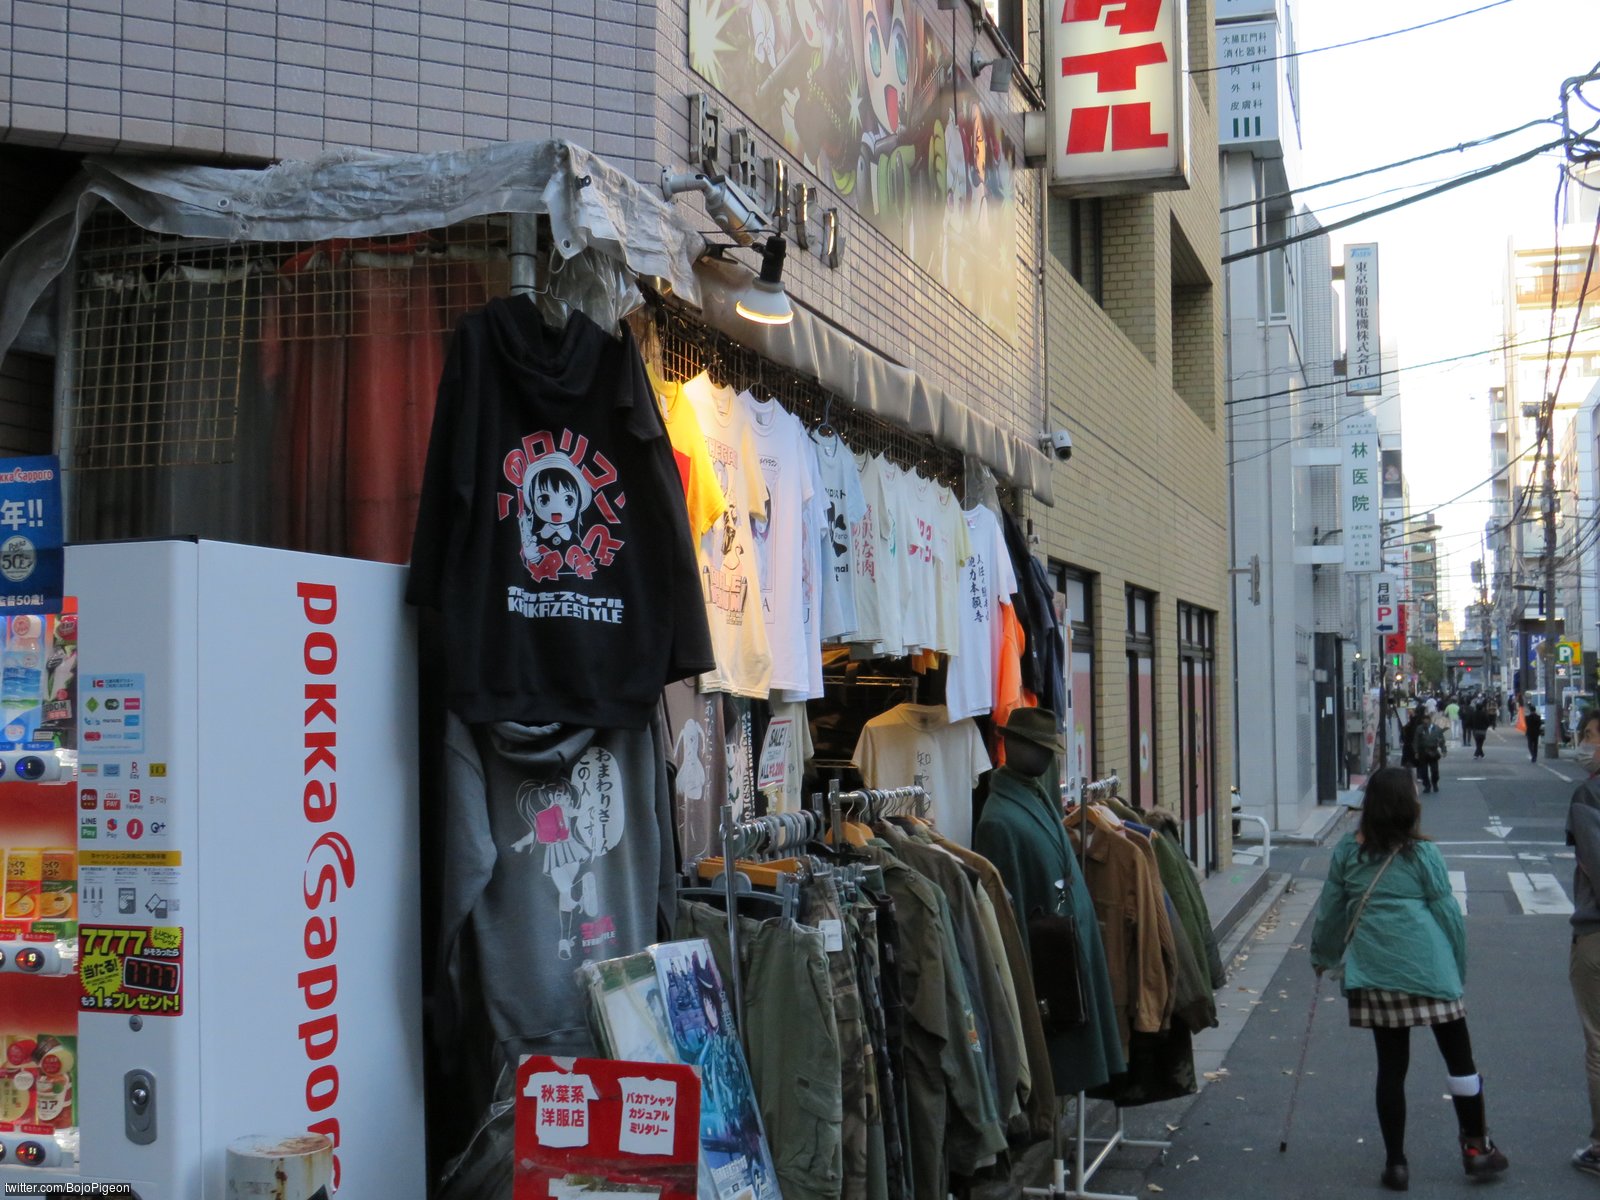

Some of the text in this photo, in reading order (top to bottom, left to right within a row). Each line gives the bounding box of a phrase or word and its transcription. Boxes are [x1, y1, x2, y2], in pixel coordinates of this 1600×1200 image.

[1223, 32, 1267, 45] 大腸肛門科
[1224, 45, 1267, 59] 消化器科
[1230, 99, 1262, 111] 皮膚科
[1355, 261, 1370, 376] 東京船舶電機株式会社
[1351, 441, 1370, 512] 林医院
[1377, 582, 1392, 622] 月極 P
[1559, 646, 1571, 662] P
[81, 929, 147, 955] 7777
[297, 860, 341, 1194] sappor
[541, 1084, 585, 1104] 秋葉系
[625, 1091, 674, 1107] バカTシャツ
[541, 1108, 585, 1128] 洋服店
[629, 1107, 670, 1121] カジュアル
[629, 1122, 668, 1135] ミリタリー
